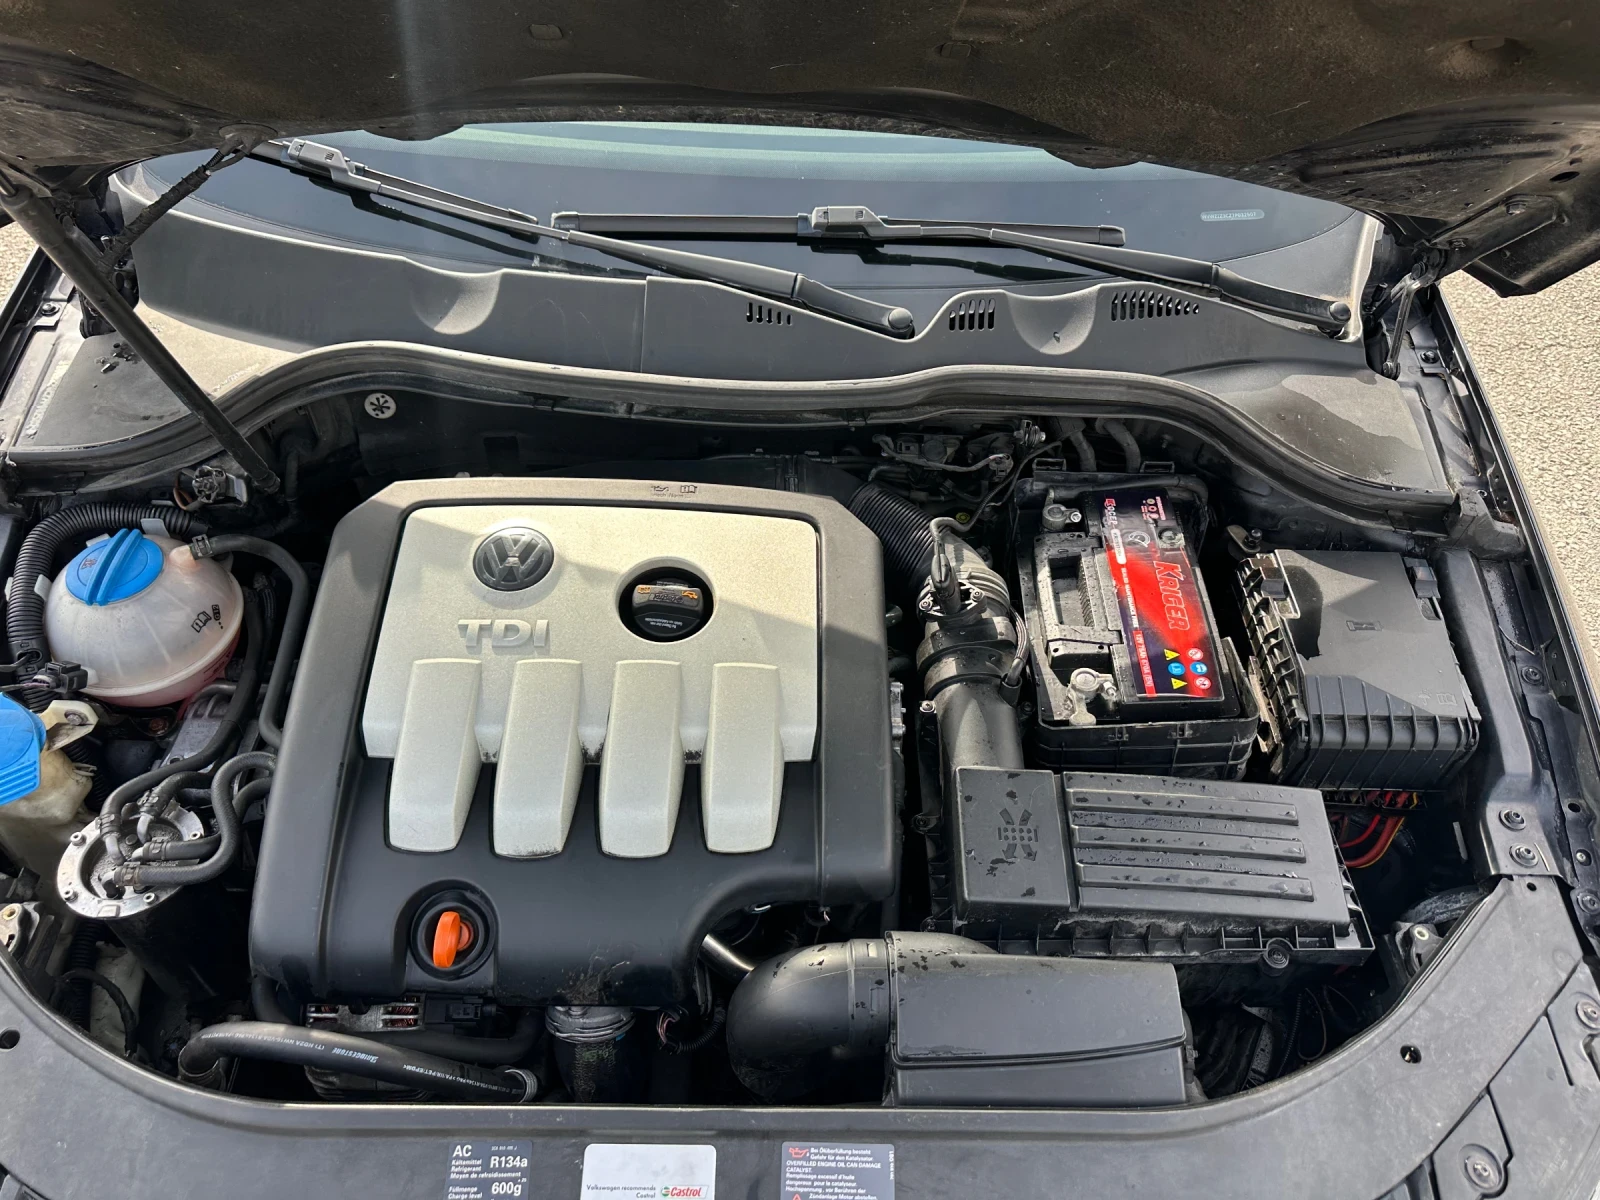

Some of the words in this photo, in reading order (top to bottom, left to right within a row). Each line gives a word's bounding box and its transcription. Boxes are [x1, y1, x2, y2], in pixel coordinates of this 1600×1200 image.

[458, 619, 550, 648] TDI
[453, 1144, 472, 1157] AC
[490, 1156, 528, 1168] R134a
[492, 1182, 522, 1196] 600g
[670, 1187, 702, 1197] Castrol
